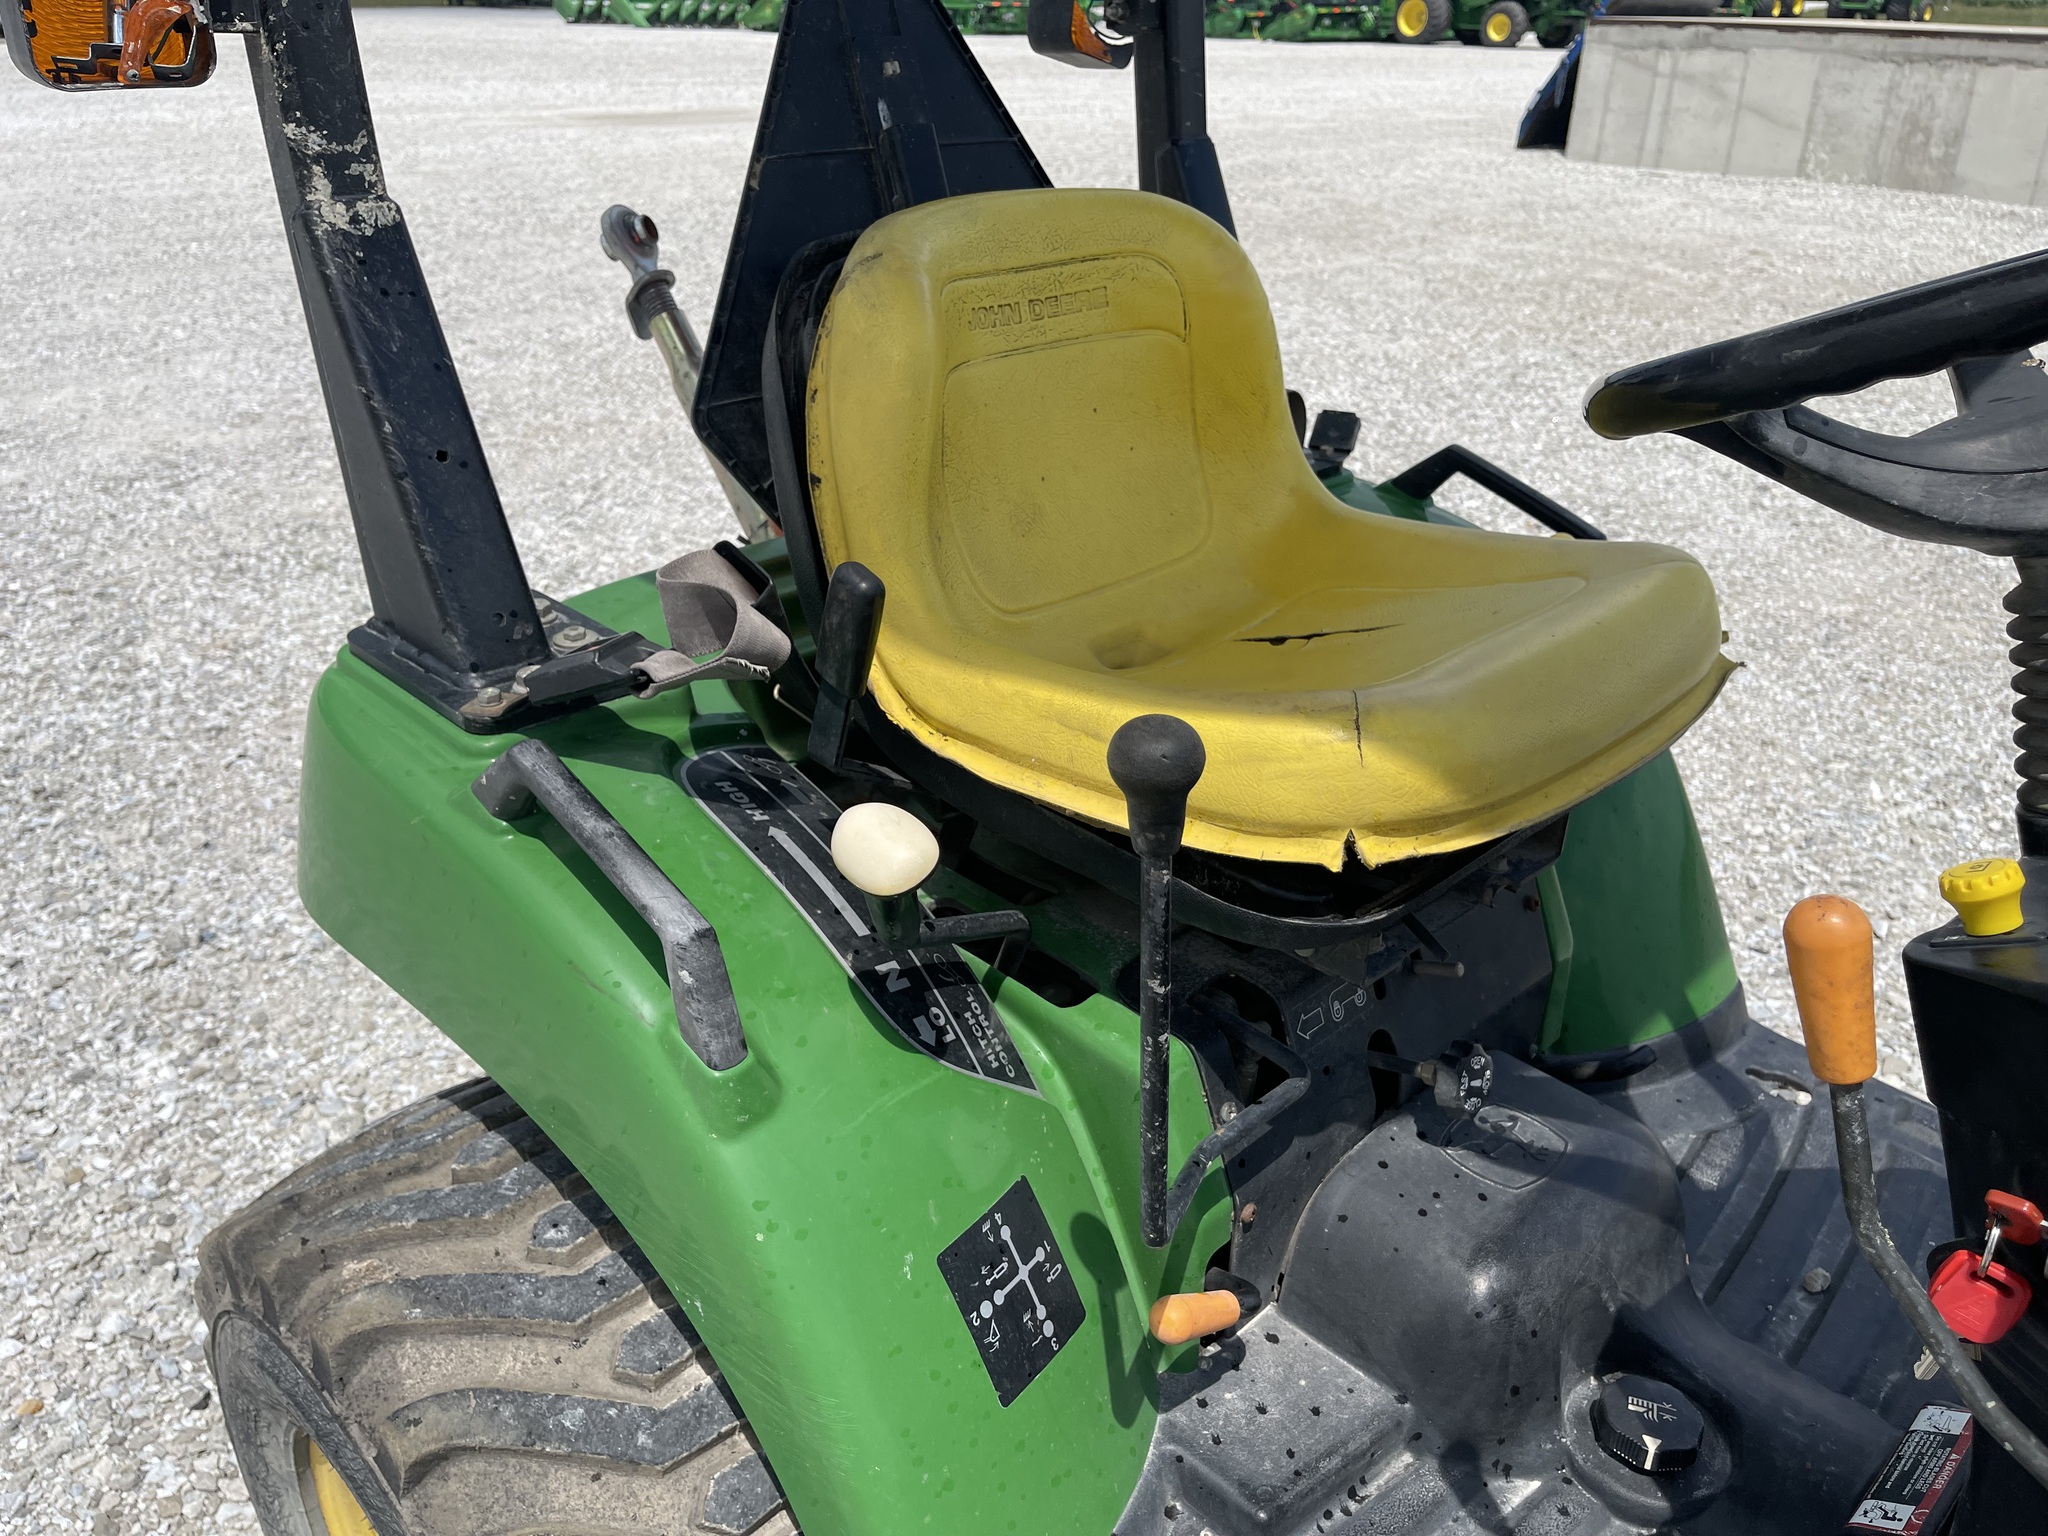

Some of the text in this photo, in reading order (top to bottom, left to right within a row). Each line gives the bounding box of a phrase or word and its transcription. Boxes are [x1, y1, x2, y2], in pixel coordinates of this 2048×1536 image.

[968, 286, 1109, 331] JOHN DEERE
[714, 780, 770, 822] HIGH
[874, 960, 911, 993] N
[929, 1005, 956, 1043] LO
[966, 991, 1016, 1078] CONTROL
[964, 1010, 1000, 1069] HITCH
[1470, 1055, 1485, 1067] OPEN
[1459, 1069, 1468, 1096] FAST
[994, 1212, 1002, 1225] 4
[970, 1310, 981, 1327] 2
[1051, 1337, 1060, 1351] 3
[1934, 1448, 1944, 1456] OFF
[1931, 1461, 1956, 1488] DANGER
